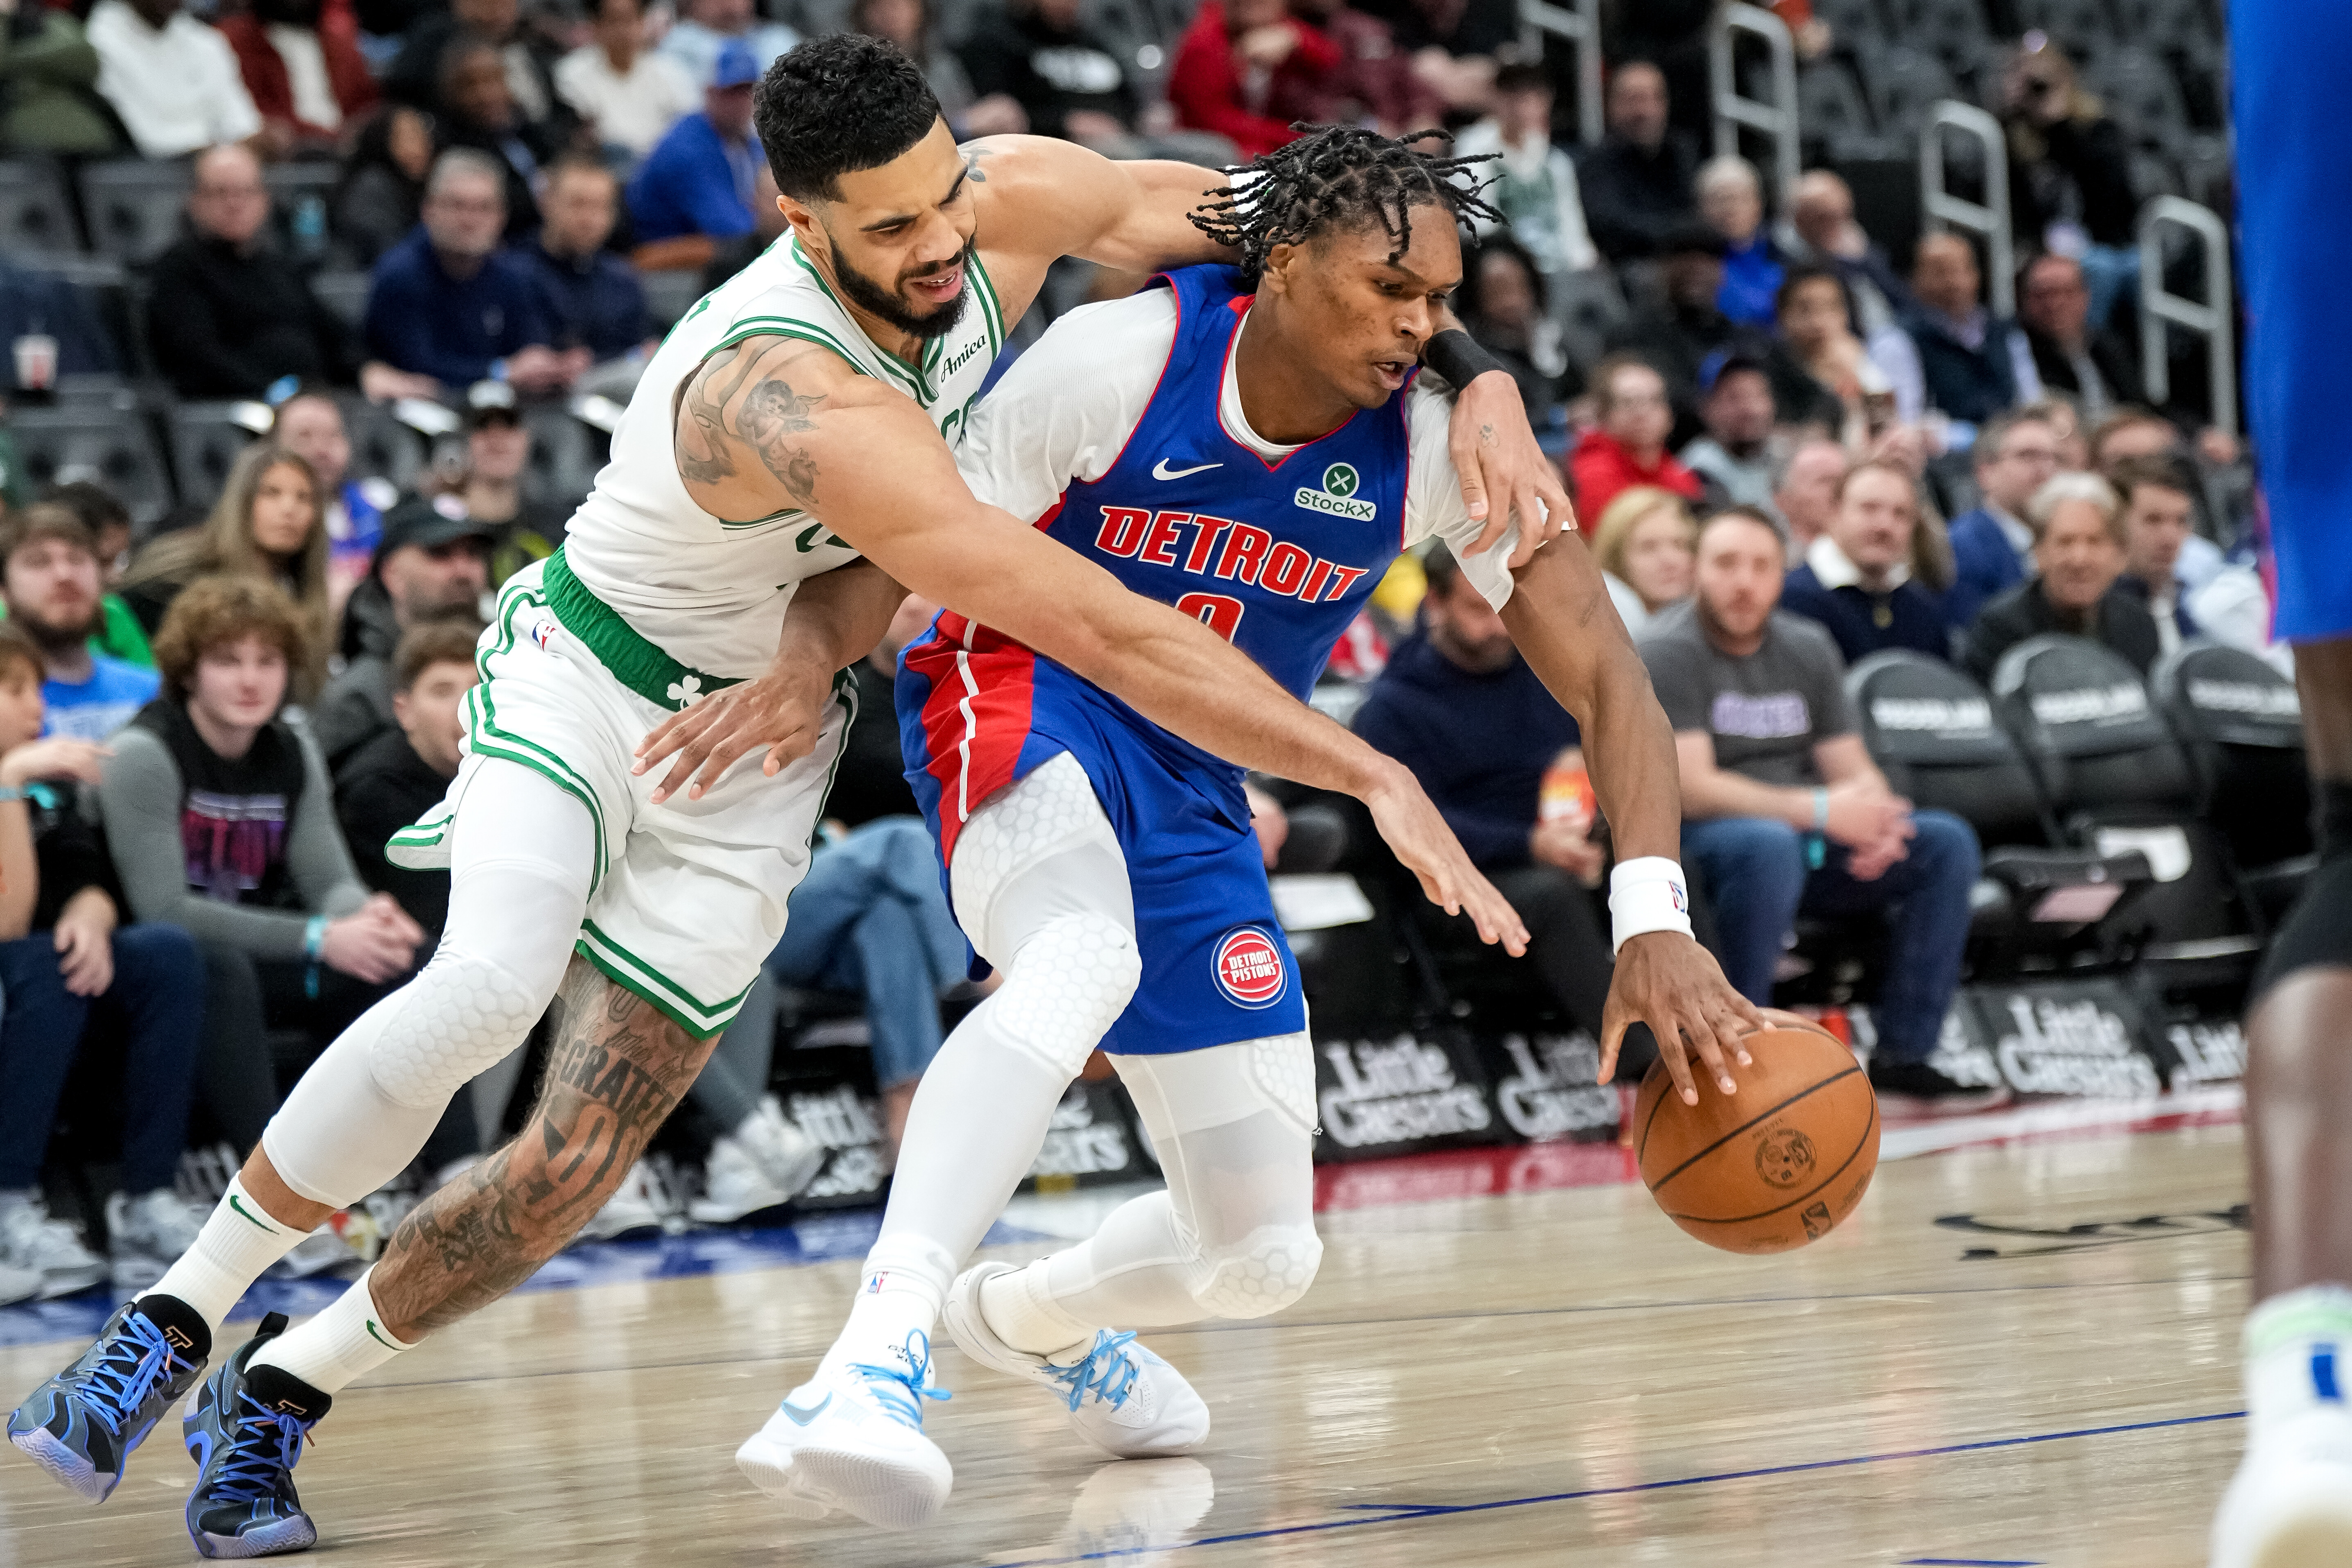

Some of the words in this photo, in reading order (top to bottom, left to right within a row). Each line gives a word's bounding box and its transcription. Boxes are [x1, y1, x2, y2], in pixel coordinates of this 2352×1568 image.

[941, 334, 986, 383] Amica
[1297, 491, 1373, 519] StockX
[1094, 505, 1370, 604] DETROIT
[1227, 950, 1272, 971] DETROIT
[1230, 963, 1277, 984] PISTONS
